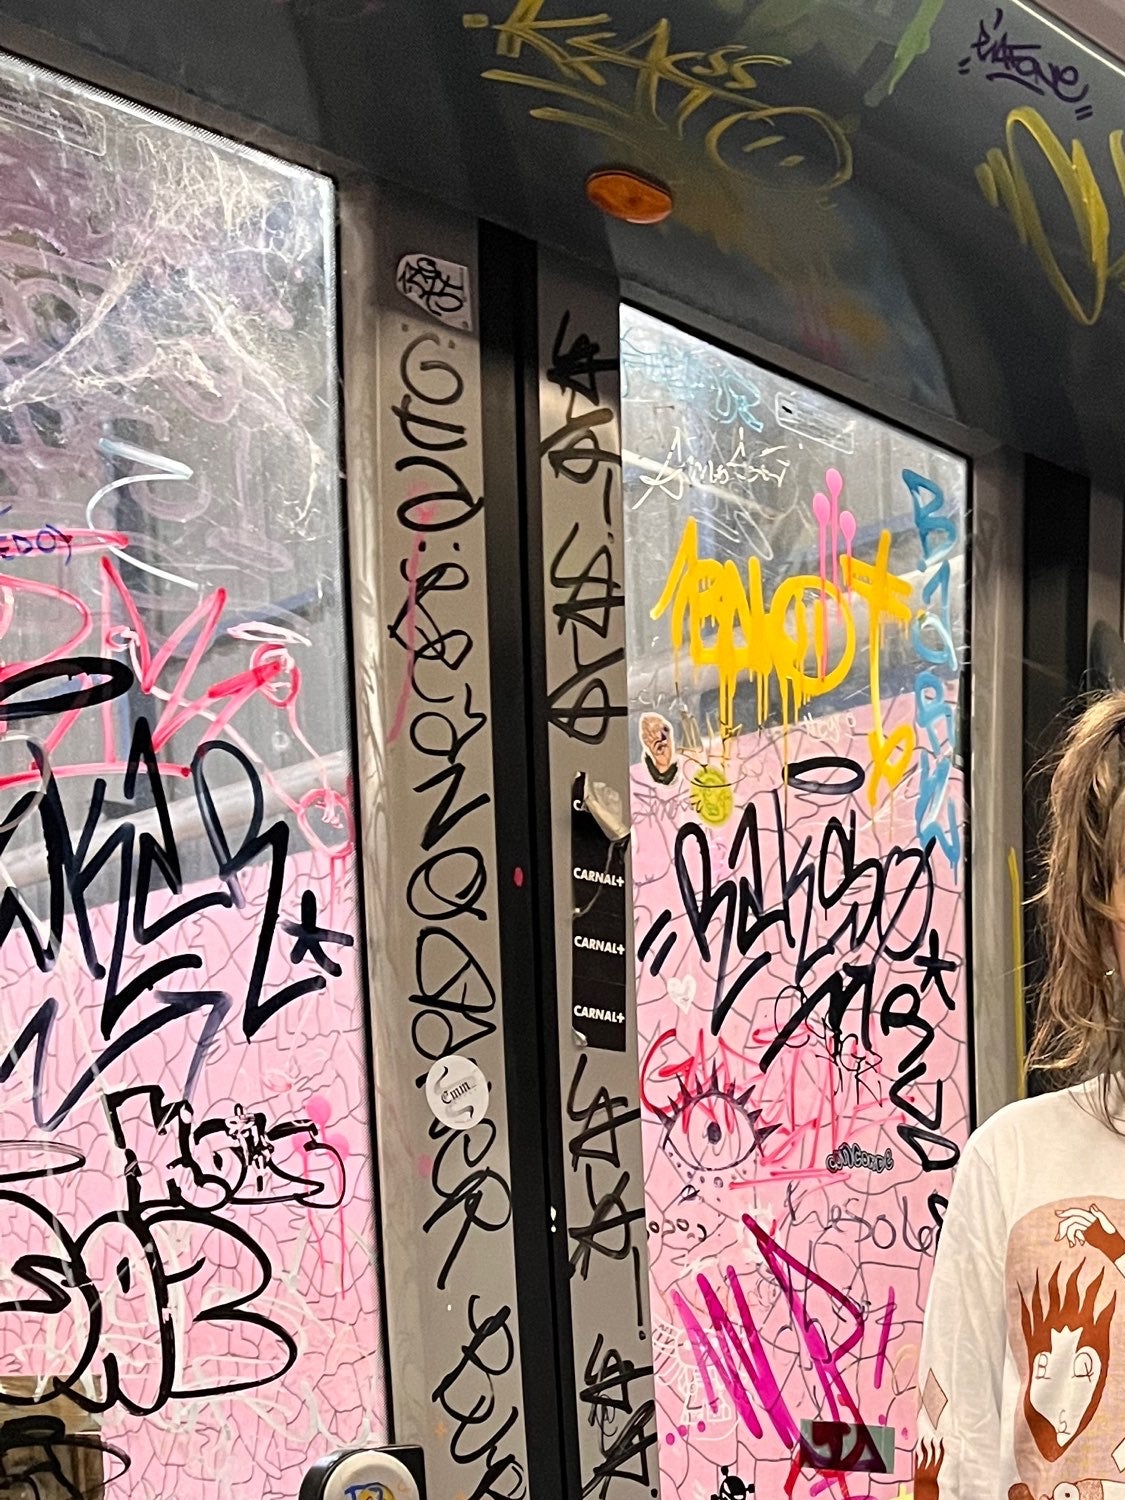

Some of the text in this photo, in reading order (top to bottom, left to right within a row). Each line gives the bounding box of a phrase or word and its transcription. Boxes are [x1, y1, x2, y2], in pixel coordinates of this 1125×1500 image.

[573, 867, 625, 888] CARNAL+
[573, 935, 626, 956] CARNAL+
[573, 1004, 626, 1024] CARNAL+
